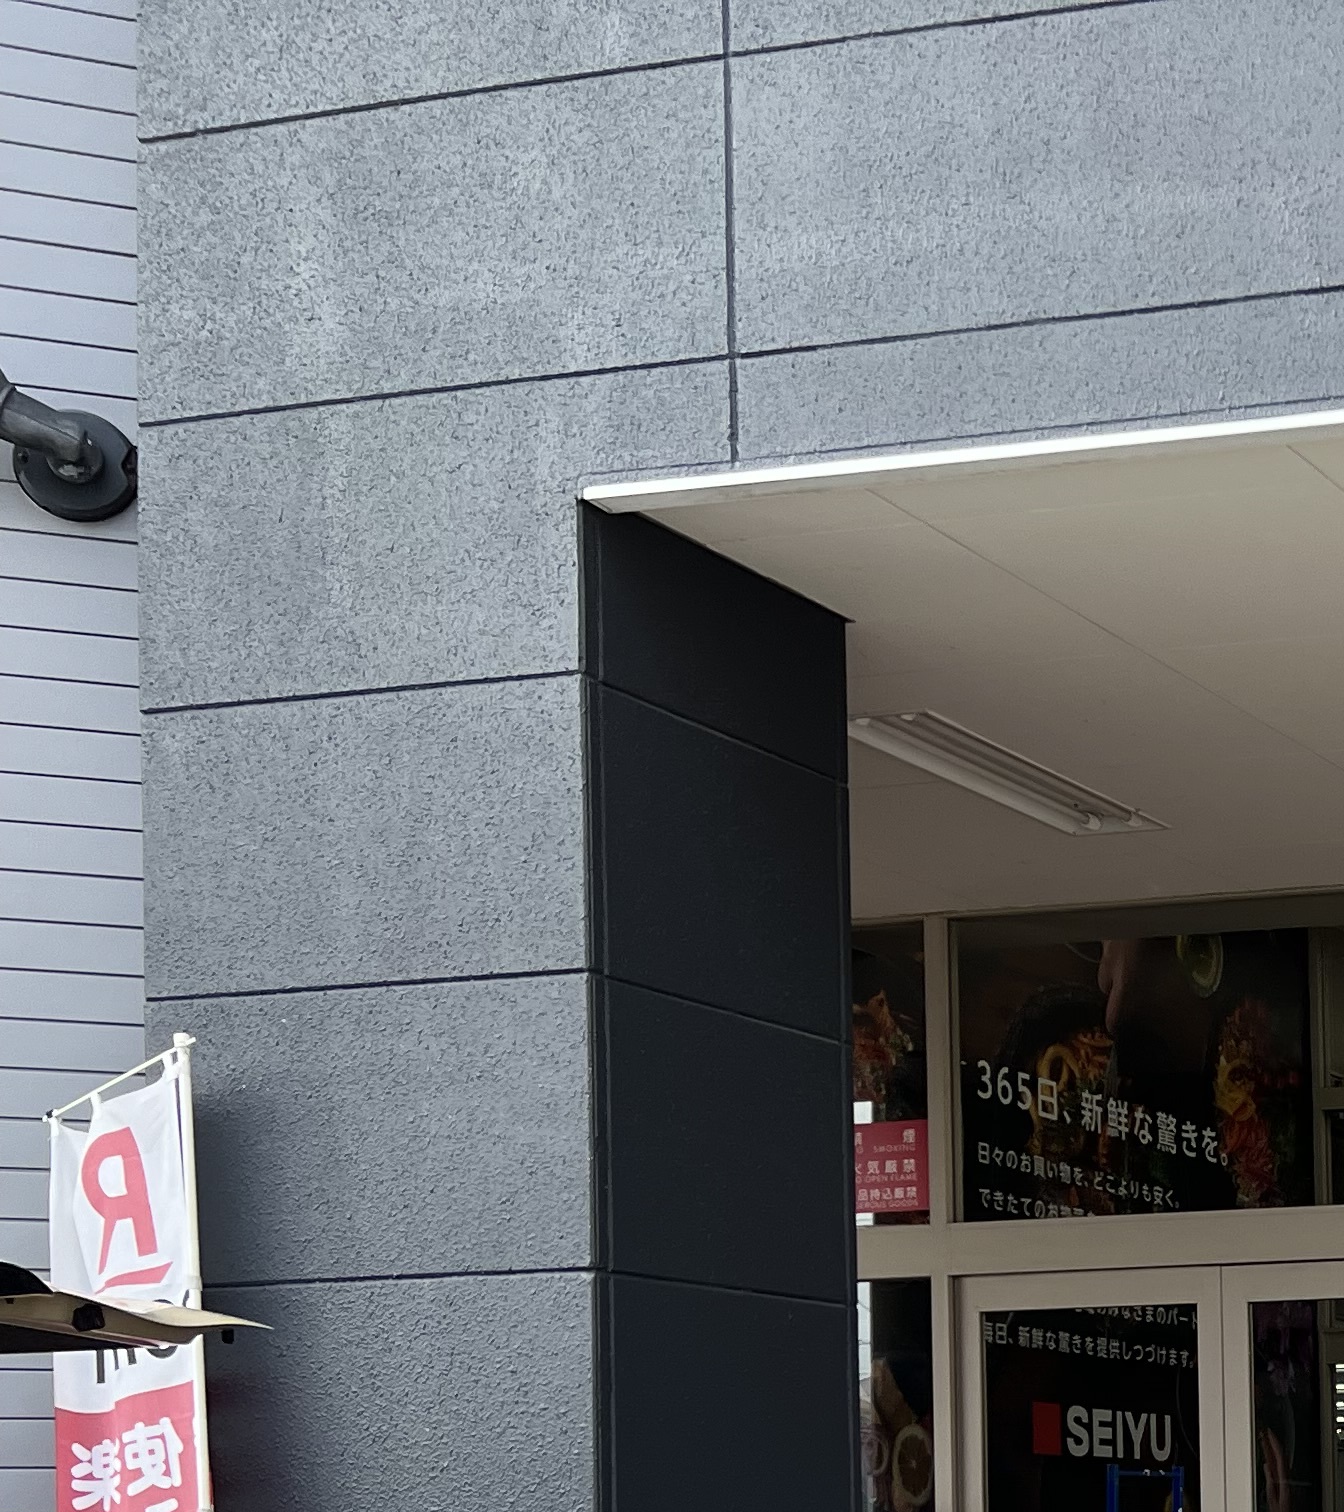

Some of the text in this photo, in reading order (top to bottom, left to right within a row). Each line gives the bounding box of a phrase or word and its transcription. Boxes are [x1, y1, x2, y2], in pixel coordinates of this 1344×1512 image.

[977, 1059, 1228, 1165] 365日、新鮮な驚きを。
[978, 1142, 1179, 1208] 日々のお買い物を、どこよりも安く。
[1066, 1404, 1171, 1461] SEIYU
